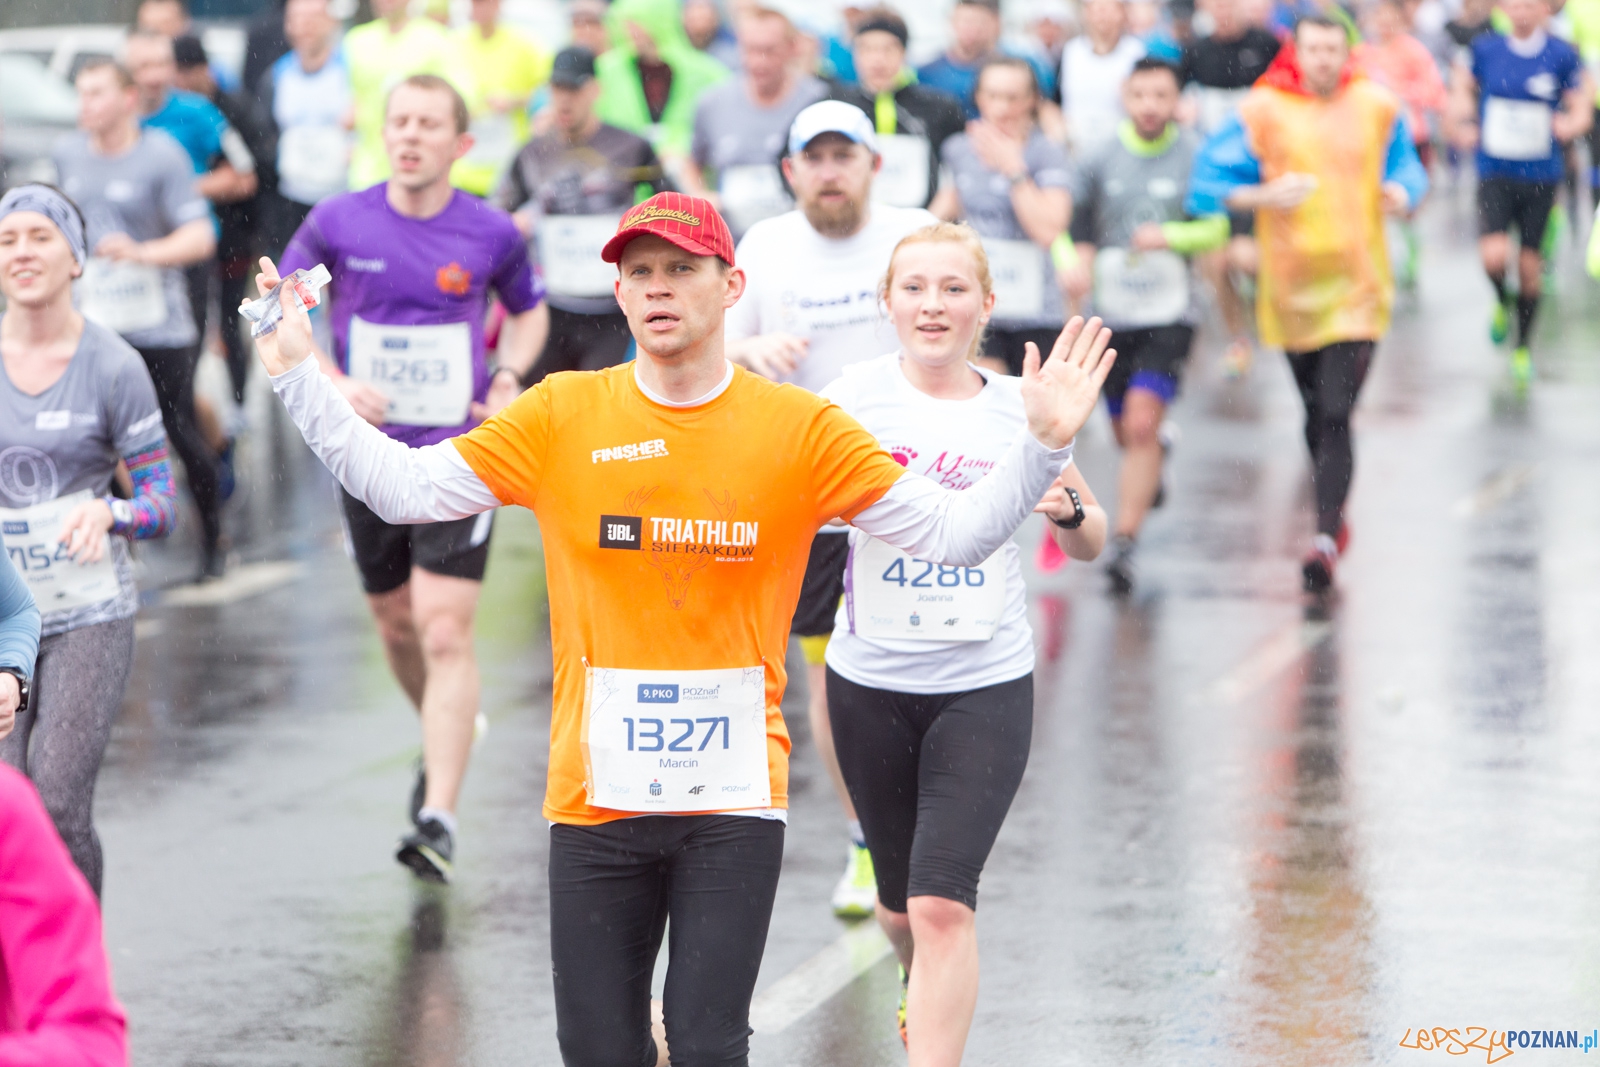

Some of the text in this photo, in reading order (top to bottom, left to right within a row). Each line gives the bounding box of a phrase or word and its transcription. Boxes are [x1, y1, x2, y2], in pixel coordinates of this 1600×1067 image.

[642, 205, 700, 224] Francisco
[370, 357, 449, 384] 11263
[591, 439, 667, 464] FINISHER
[607, 517, 759, 546] JBL TRIATHLON
[882, 557, 985, 588] 4286
[916, 593, 954, 604] Joanna
[652, 688, 674, 699] PKO
[623, 716, 730, 752] 13271
[659, 758, 699, 768] Marcin
